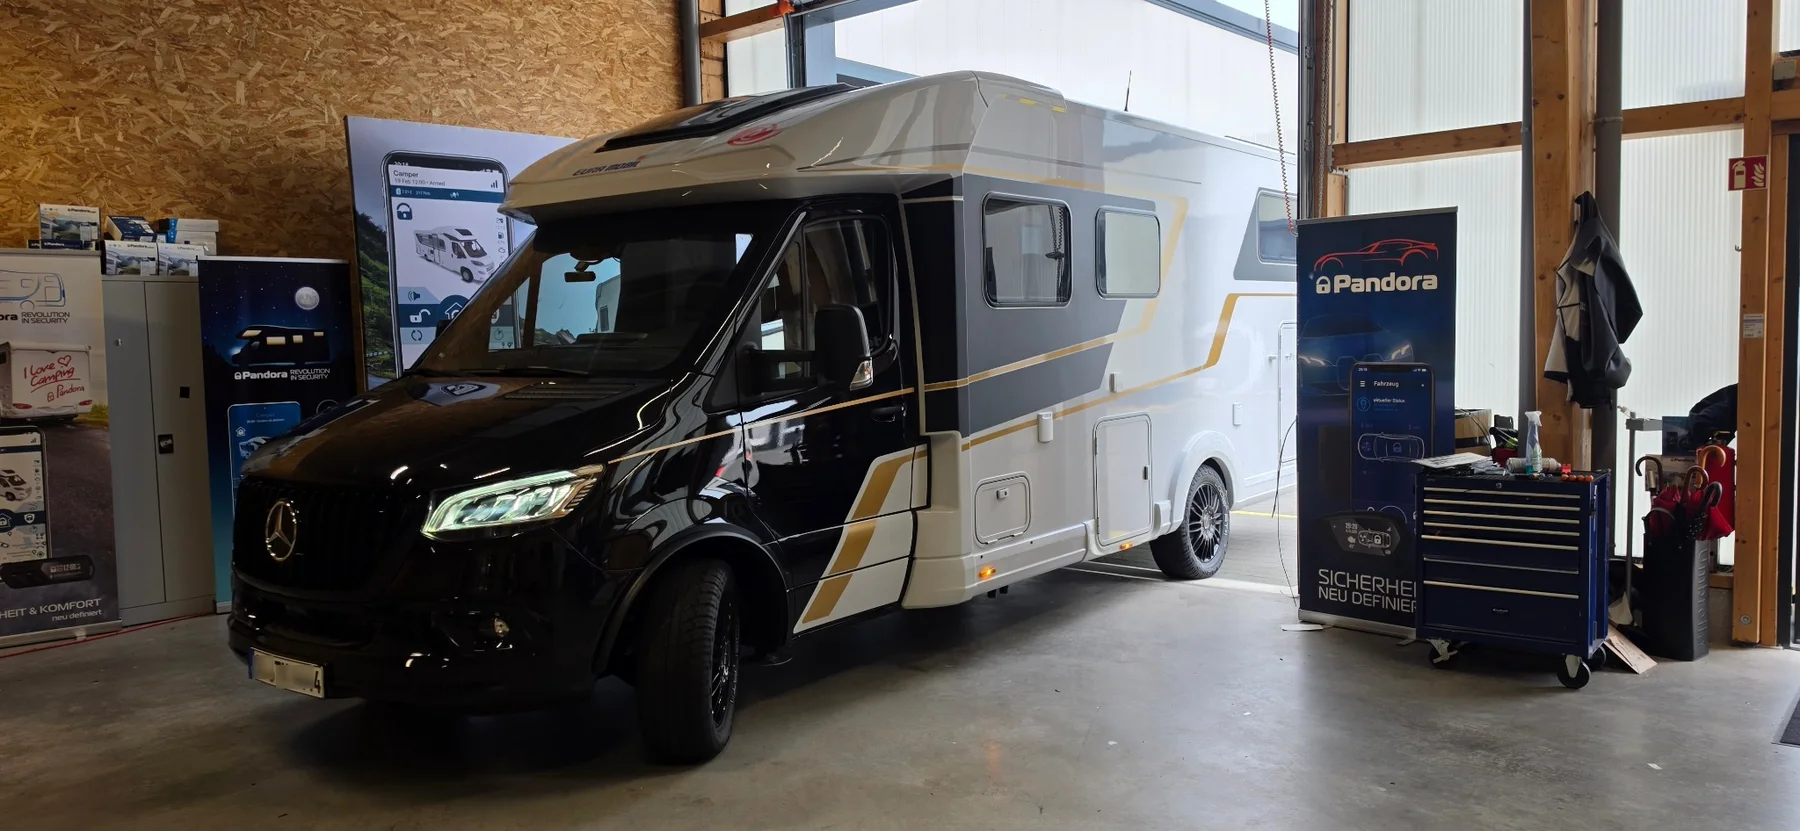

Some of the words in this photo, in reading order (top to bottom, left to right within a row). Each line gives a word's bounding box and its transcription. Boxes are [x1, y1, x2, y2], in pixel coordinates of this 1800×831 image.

[393, 170, 418, 178] Camper
[1333, 272, 1438, 293] Pandora
[30, 362, 55, 376] Love
[242, 370, 288, 380] Pandora
[31, 367, 75, 387] Camping
[298, 373, 329, 381] SECURITY
[1373, 380, 1400, 388] Fahrzeug
[56, 383, 85, 399] Pandora
[1318, 568, 1417, 598] SICHERHEI
[1318, 585, 1347, 603] NEU
[29, 607, 38, 615] &
[40, 598, 103, 614] KOMFORT
[69, 609, 102, 619] definiert
